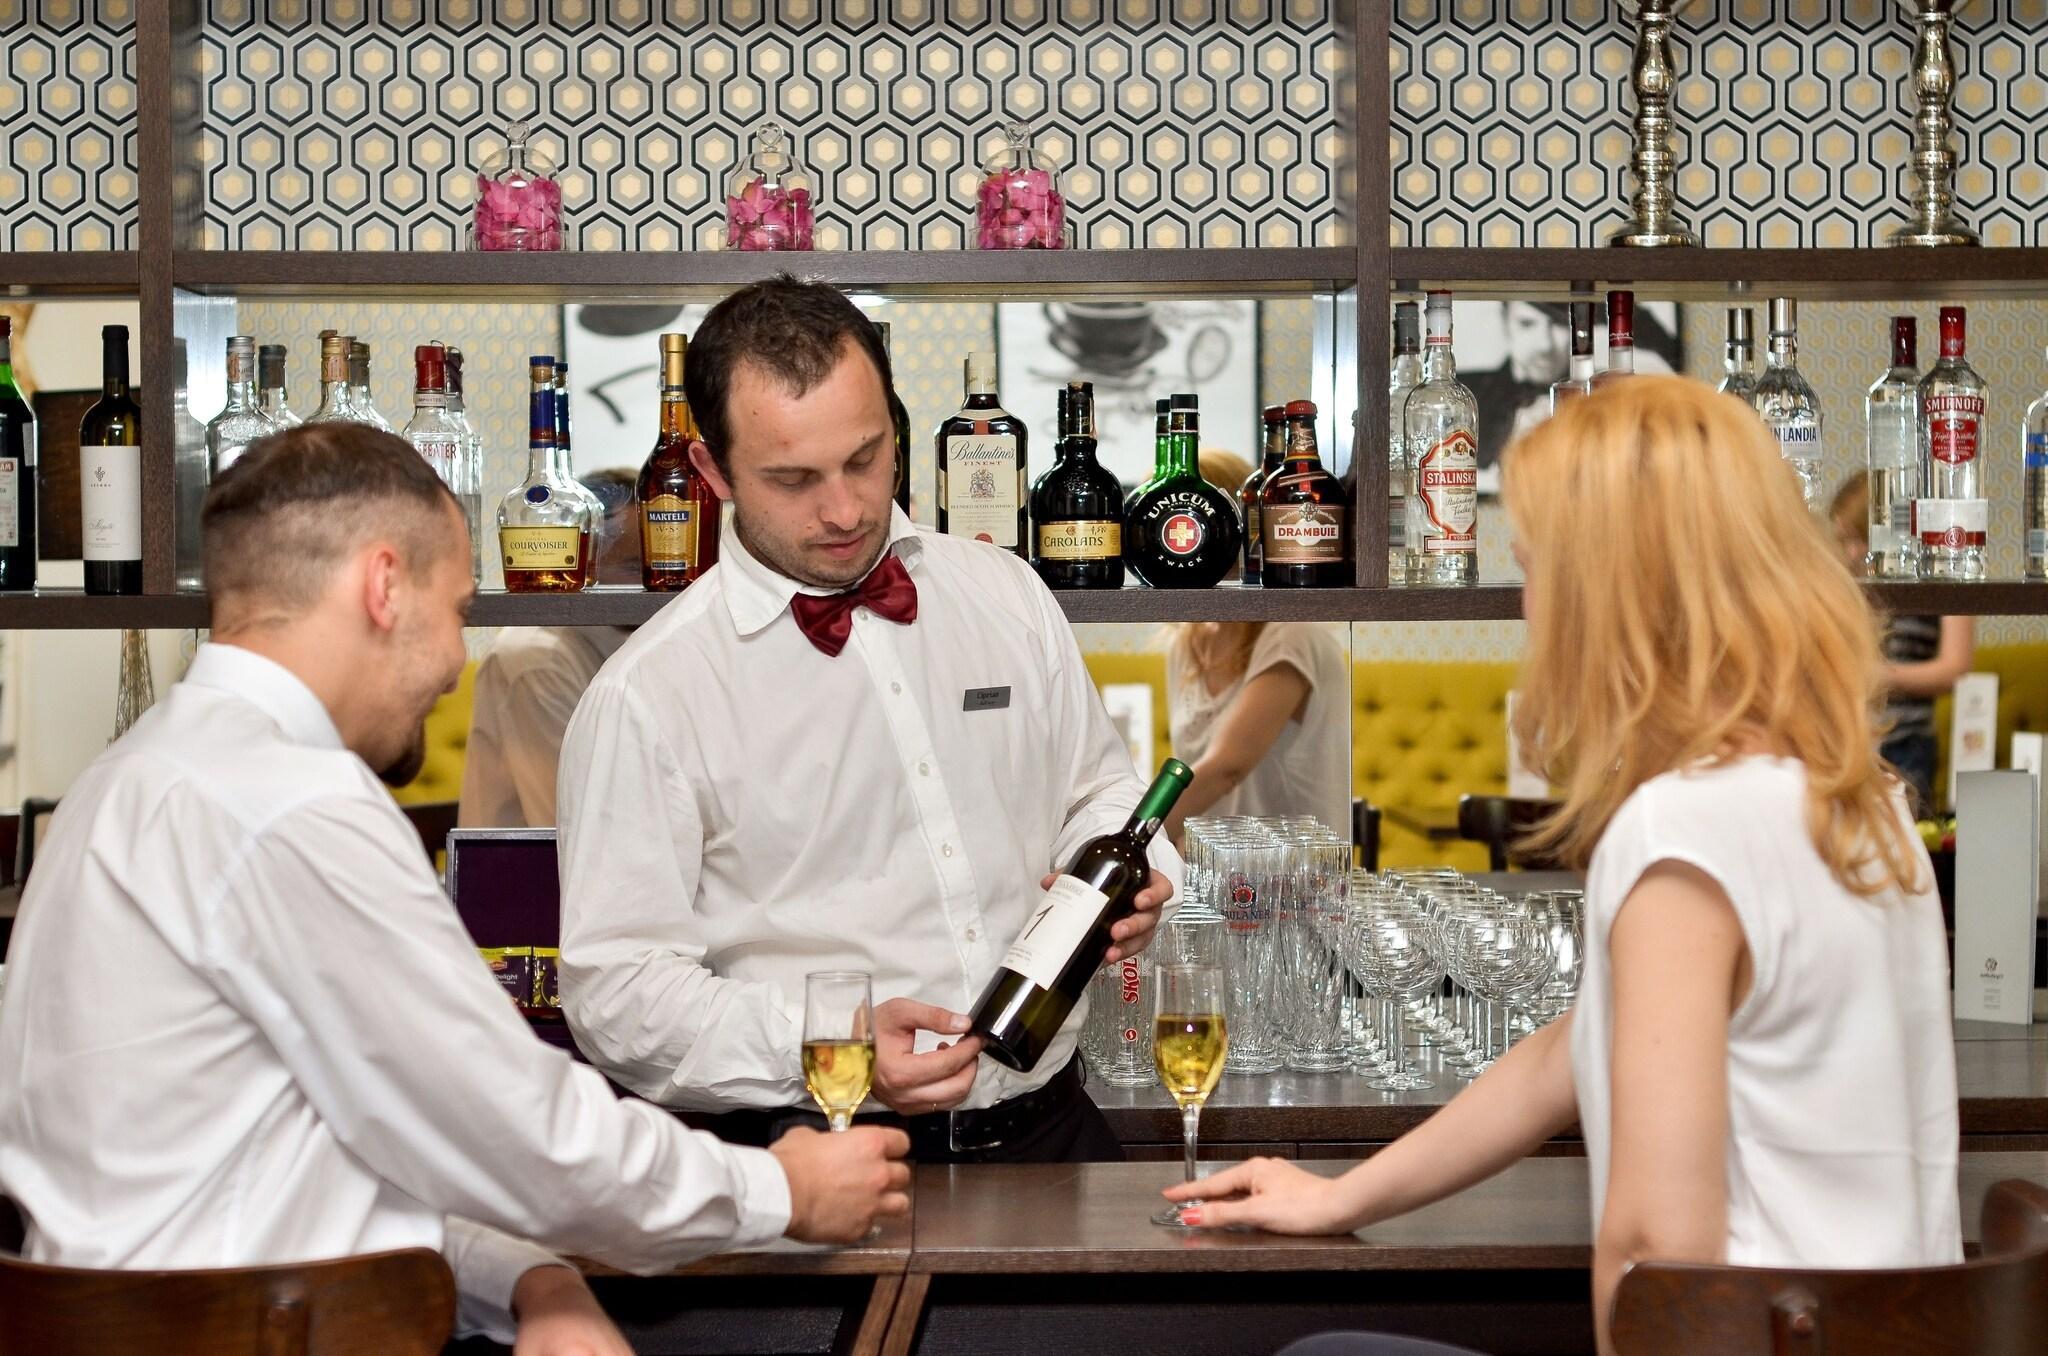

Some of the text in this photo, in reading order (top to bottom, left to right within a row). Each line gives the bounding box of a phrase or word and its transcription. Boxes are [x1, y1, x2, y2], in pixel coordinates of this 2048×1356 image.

[1926, 397, 1982, 413] SMIRNOFF
[951, 440, 1015, 461] Ballantine's
[1147, 492, 1216, 519] UNICUM
[649, 513, 687, 521] MARTELL
[1278, 527, 1336, 537] DRAMBUIE
[509, 542, 568, 553] COURVOISIER
[1043, 536, 1104, 548] CAROLANS
[1158, 554, 1203, 568] ZWACK
[1122, 956, 1141, 1005] SKOL
